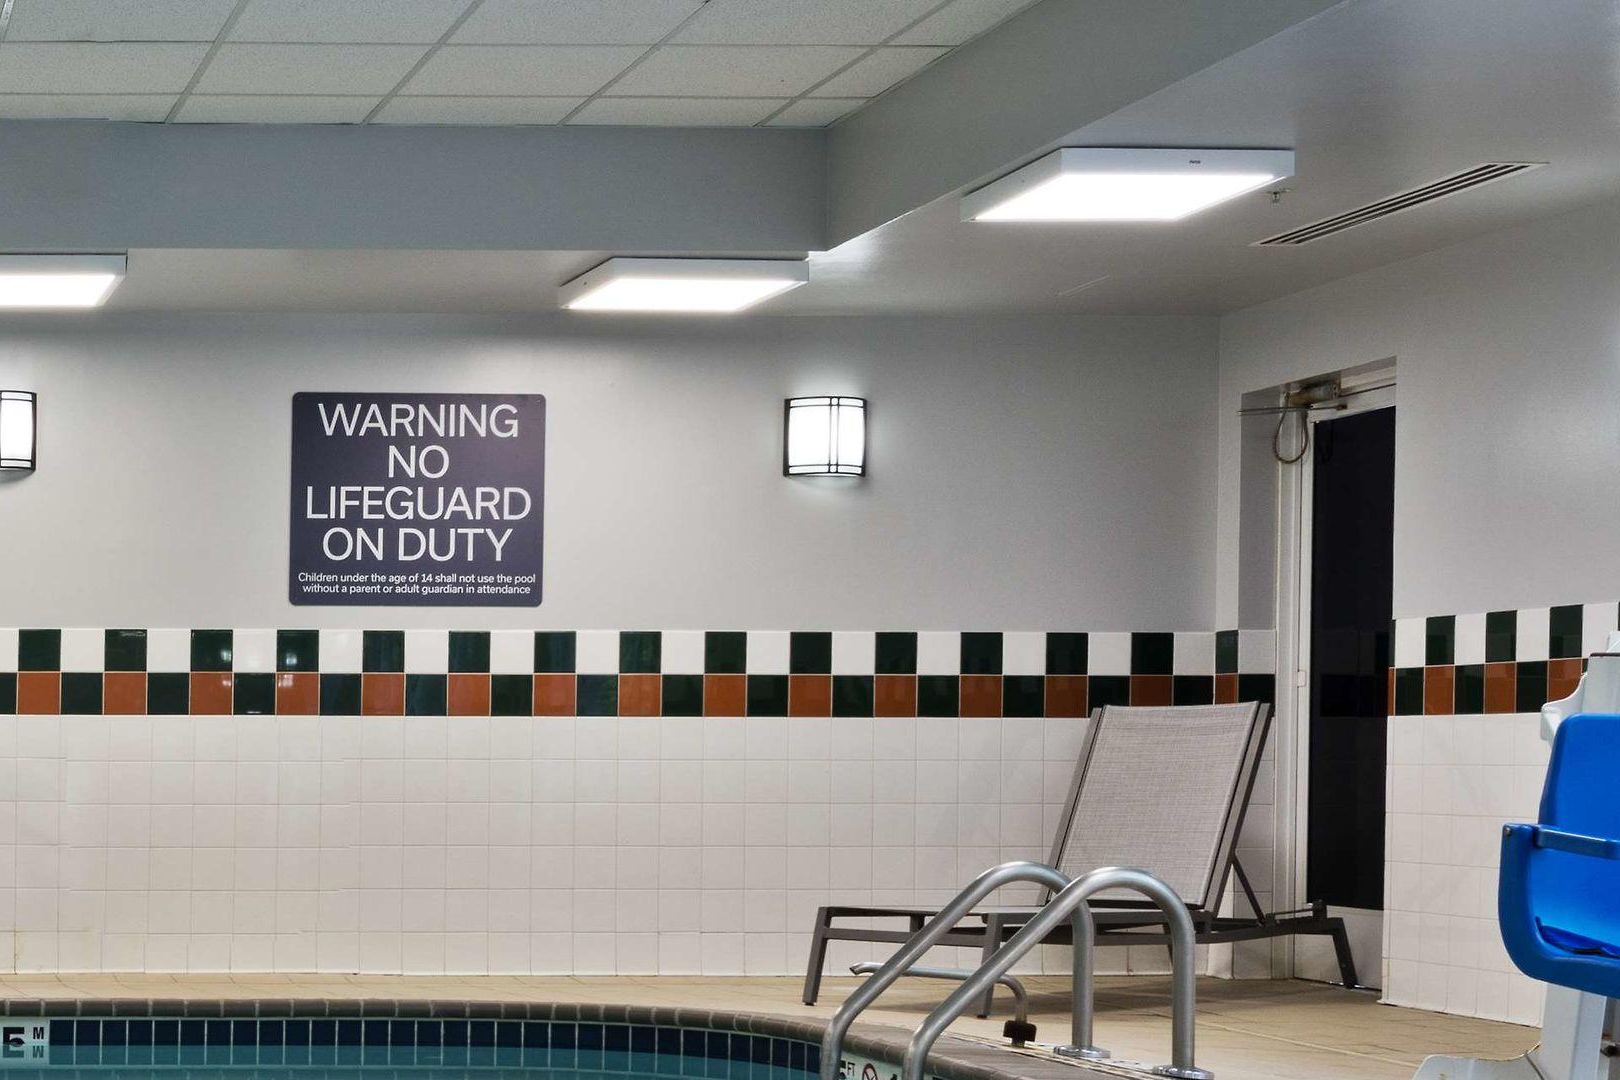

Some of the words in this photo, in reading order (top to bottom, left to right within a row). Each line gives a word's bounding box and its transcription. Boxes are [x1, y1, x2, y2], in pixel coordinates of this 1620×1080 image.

[318, 403, 519, 438] WARNING
[388, 444, 450, 479] NO
[306, 486, 531, 520] LIFEGUARD
[322, 527, 384, 561] ON
[398, 528, 513, 562] DUTY
[298, 572, 338, 582] Children
[340, 573, 369, 582] under
[371, 573, 386, 582] the
[388, 575, 406, 584] age
[408, 573, 419, 582] of
[421, 573, 432, 583] 14
[434, 573, 457, 583] shall
[459, 574, 475, 583] not
[477, 575, 495, 583] use
[496, 574, 512, 583] the
[514, 574, 536, 585] pool
[302, 583, 339, 593] without
[341, 585, 347, 593] a
[349, 584, 381, 594] parent
[382, 585, 393, 593] or
[395, 584, 420, 593] adult
[421, 584, 464, 595] guardian
[465, 584, 475, 594] in
[477, 585, 531, 594] attendance
